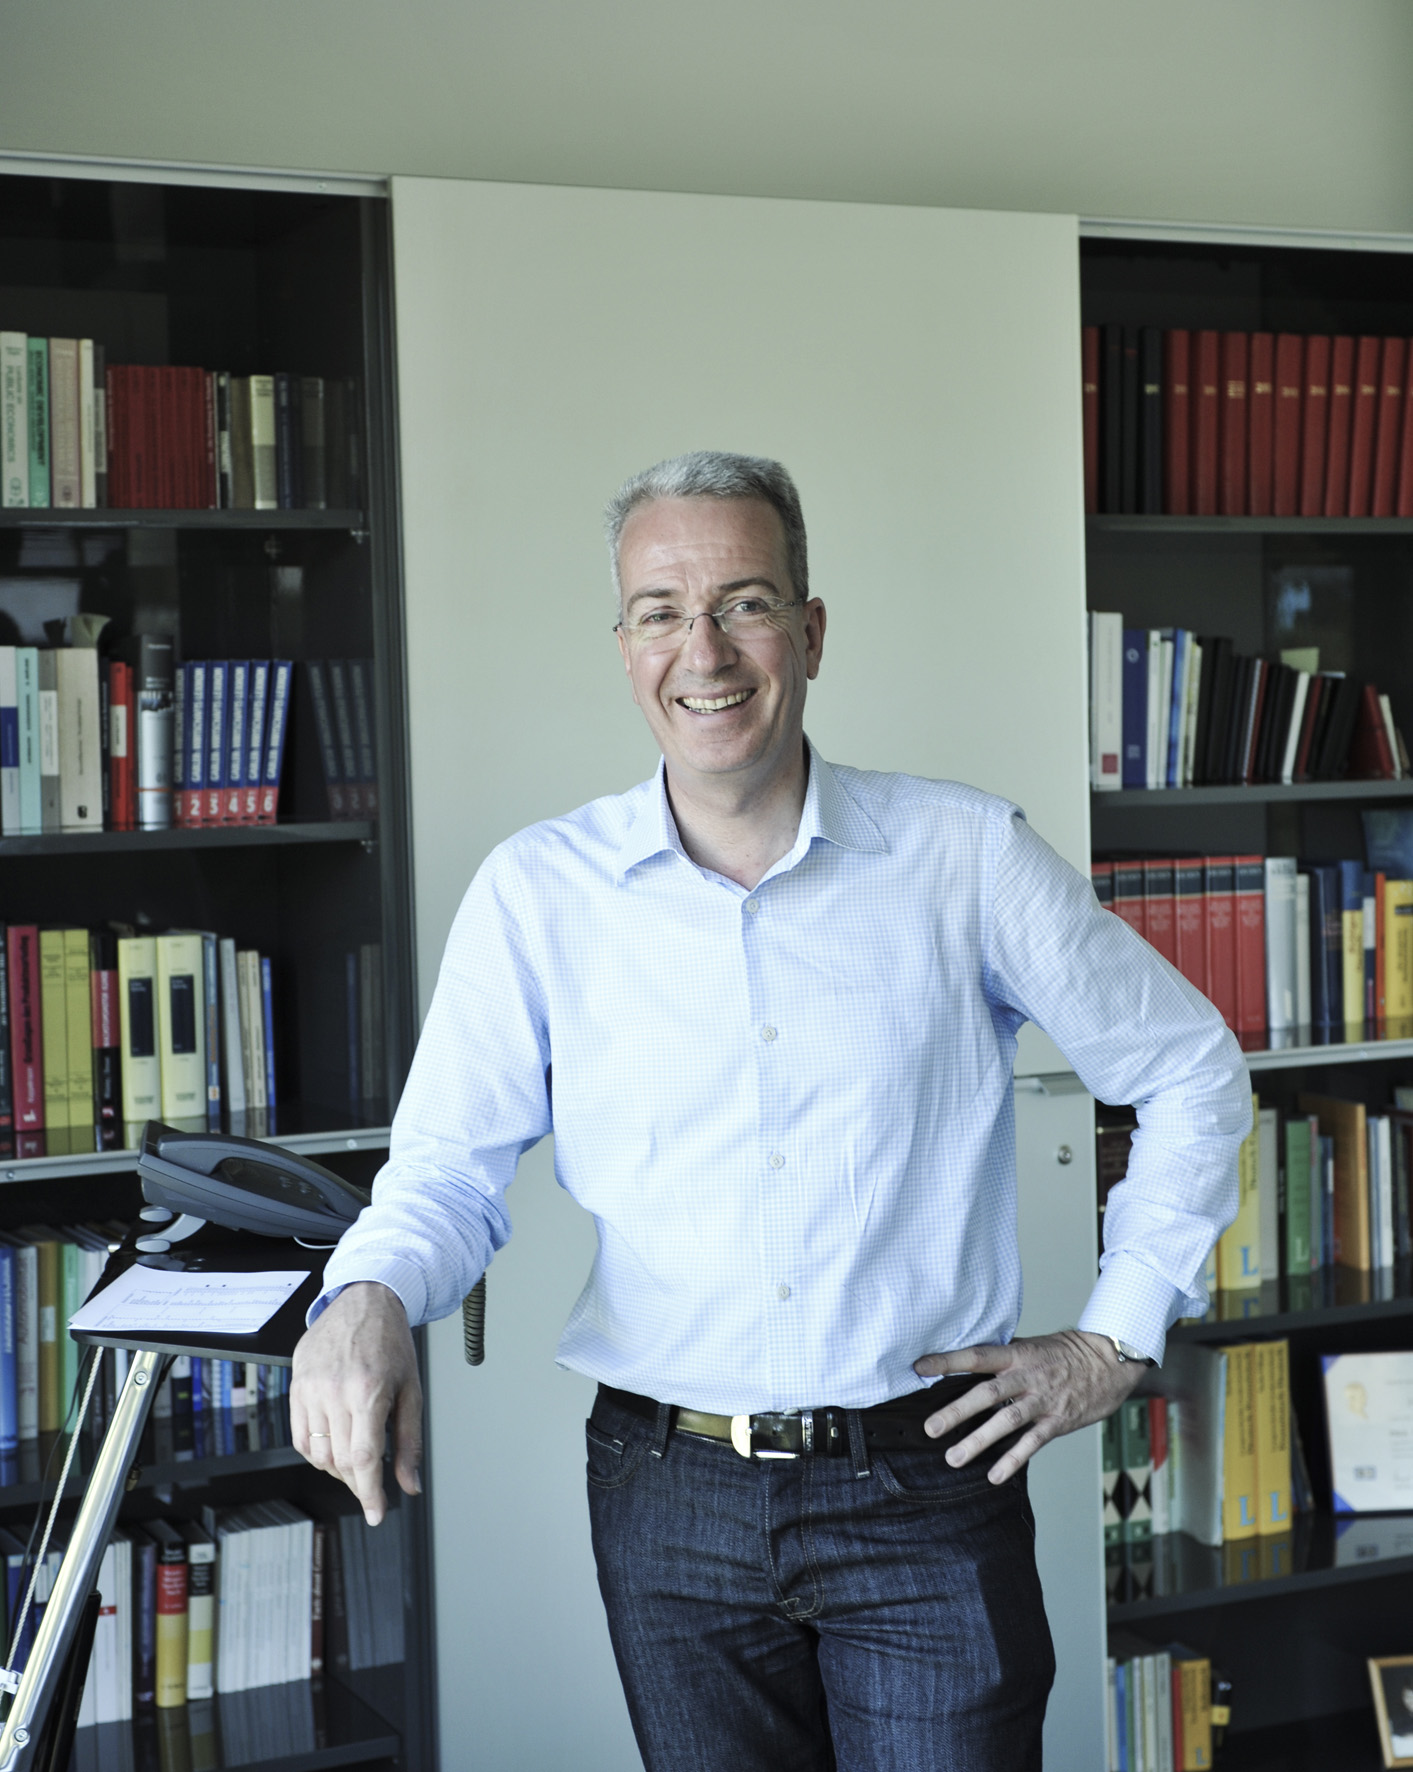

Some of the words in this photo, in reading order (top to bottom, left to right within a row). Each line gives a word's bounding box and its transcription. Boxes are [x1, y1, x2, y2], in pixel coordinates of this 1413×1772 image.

[5, 365, 15, 400] PUBLIC
[35, 351, 44, 398] ECONOMIC
[6, 402, 16, 463] ECONOMICS
[36, 400, 46, 466] DEVELOPMENT
[191, 752, 201, 782] GABLER
[210, 751, 220, 782] GABLER
[230, 751, 241, 781] GABLER
[248, 750, 260, 780] GABLER
[266, 750, 279, 780] GABLER
[175, 800, 182, 816] 1
[190, 798, 200, 816] 2
[209, 797, 219, 815] 3
[229, 796, 238, 813] 4
[246, 795, 256, 813] 5
[264, 795, 273, 812] 6
[1240, 1246, 1259, 1276] L
[1239, 1496, 1256, 1527] L
[1270, 1491, 1288, 1522] L
